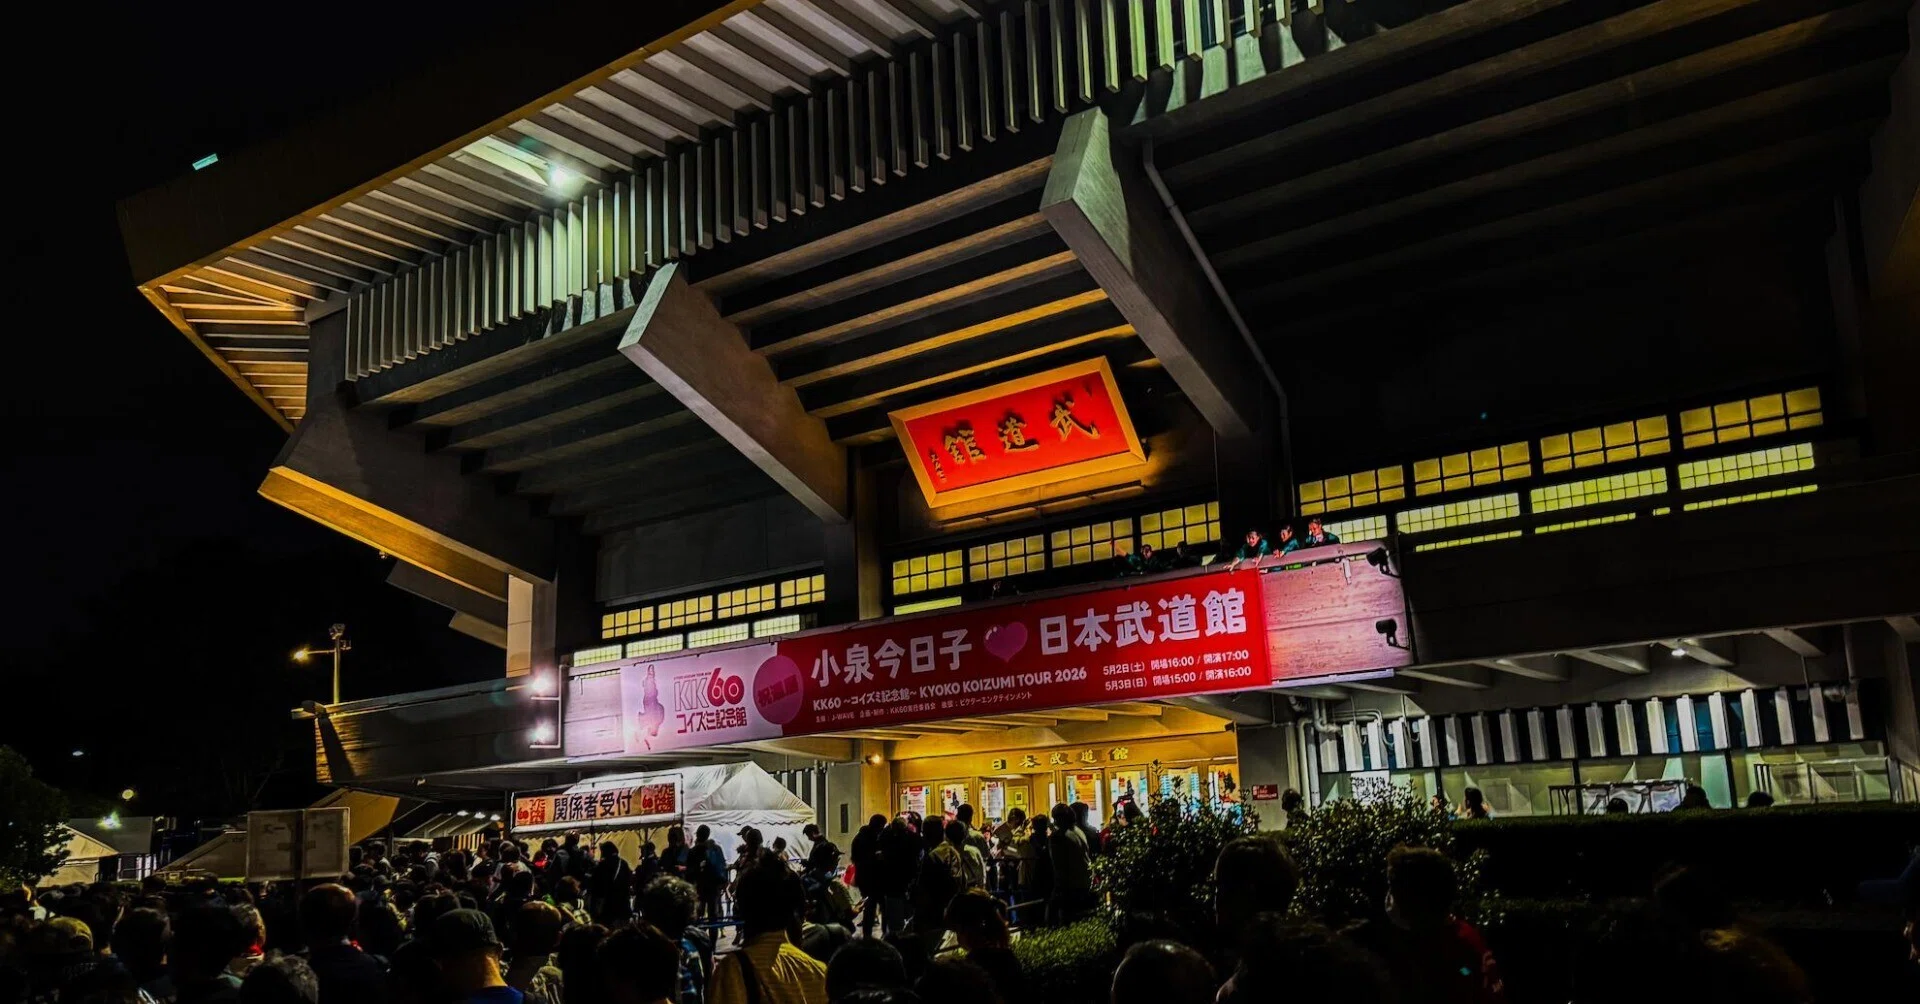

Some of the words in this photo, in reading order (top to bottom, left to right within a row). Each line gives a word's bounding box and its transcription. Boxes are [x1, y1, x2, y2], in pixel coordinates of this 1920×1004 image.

[811, 628, 972, 688] 小泉今日子
[1040, 587, 1247, 655] 日本武道館
[674, 667, 744, 711] KK60
[813, 699, 842, 711] KK60
[919, 683, 960, 699] KYOKO
[962, 677, 1015, 695] KOIZUMI
[1016, 669, 1052, 686] TOUR
[1055, 667, 1087, 683] 2026
[676, 707, 747, 733] コイズミ記念館
[991, 747, 1128, 770] 日本武道館
[554, 789, 632, 822] 関係者受付
